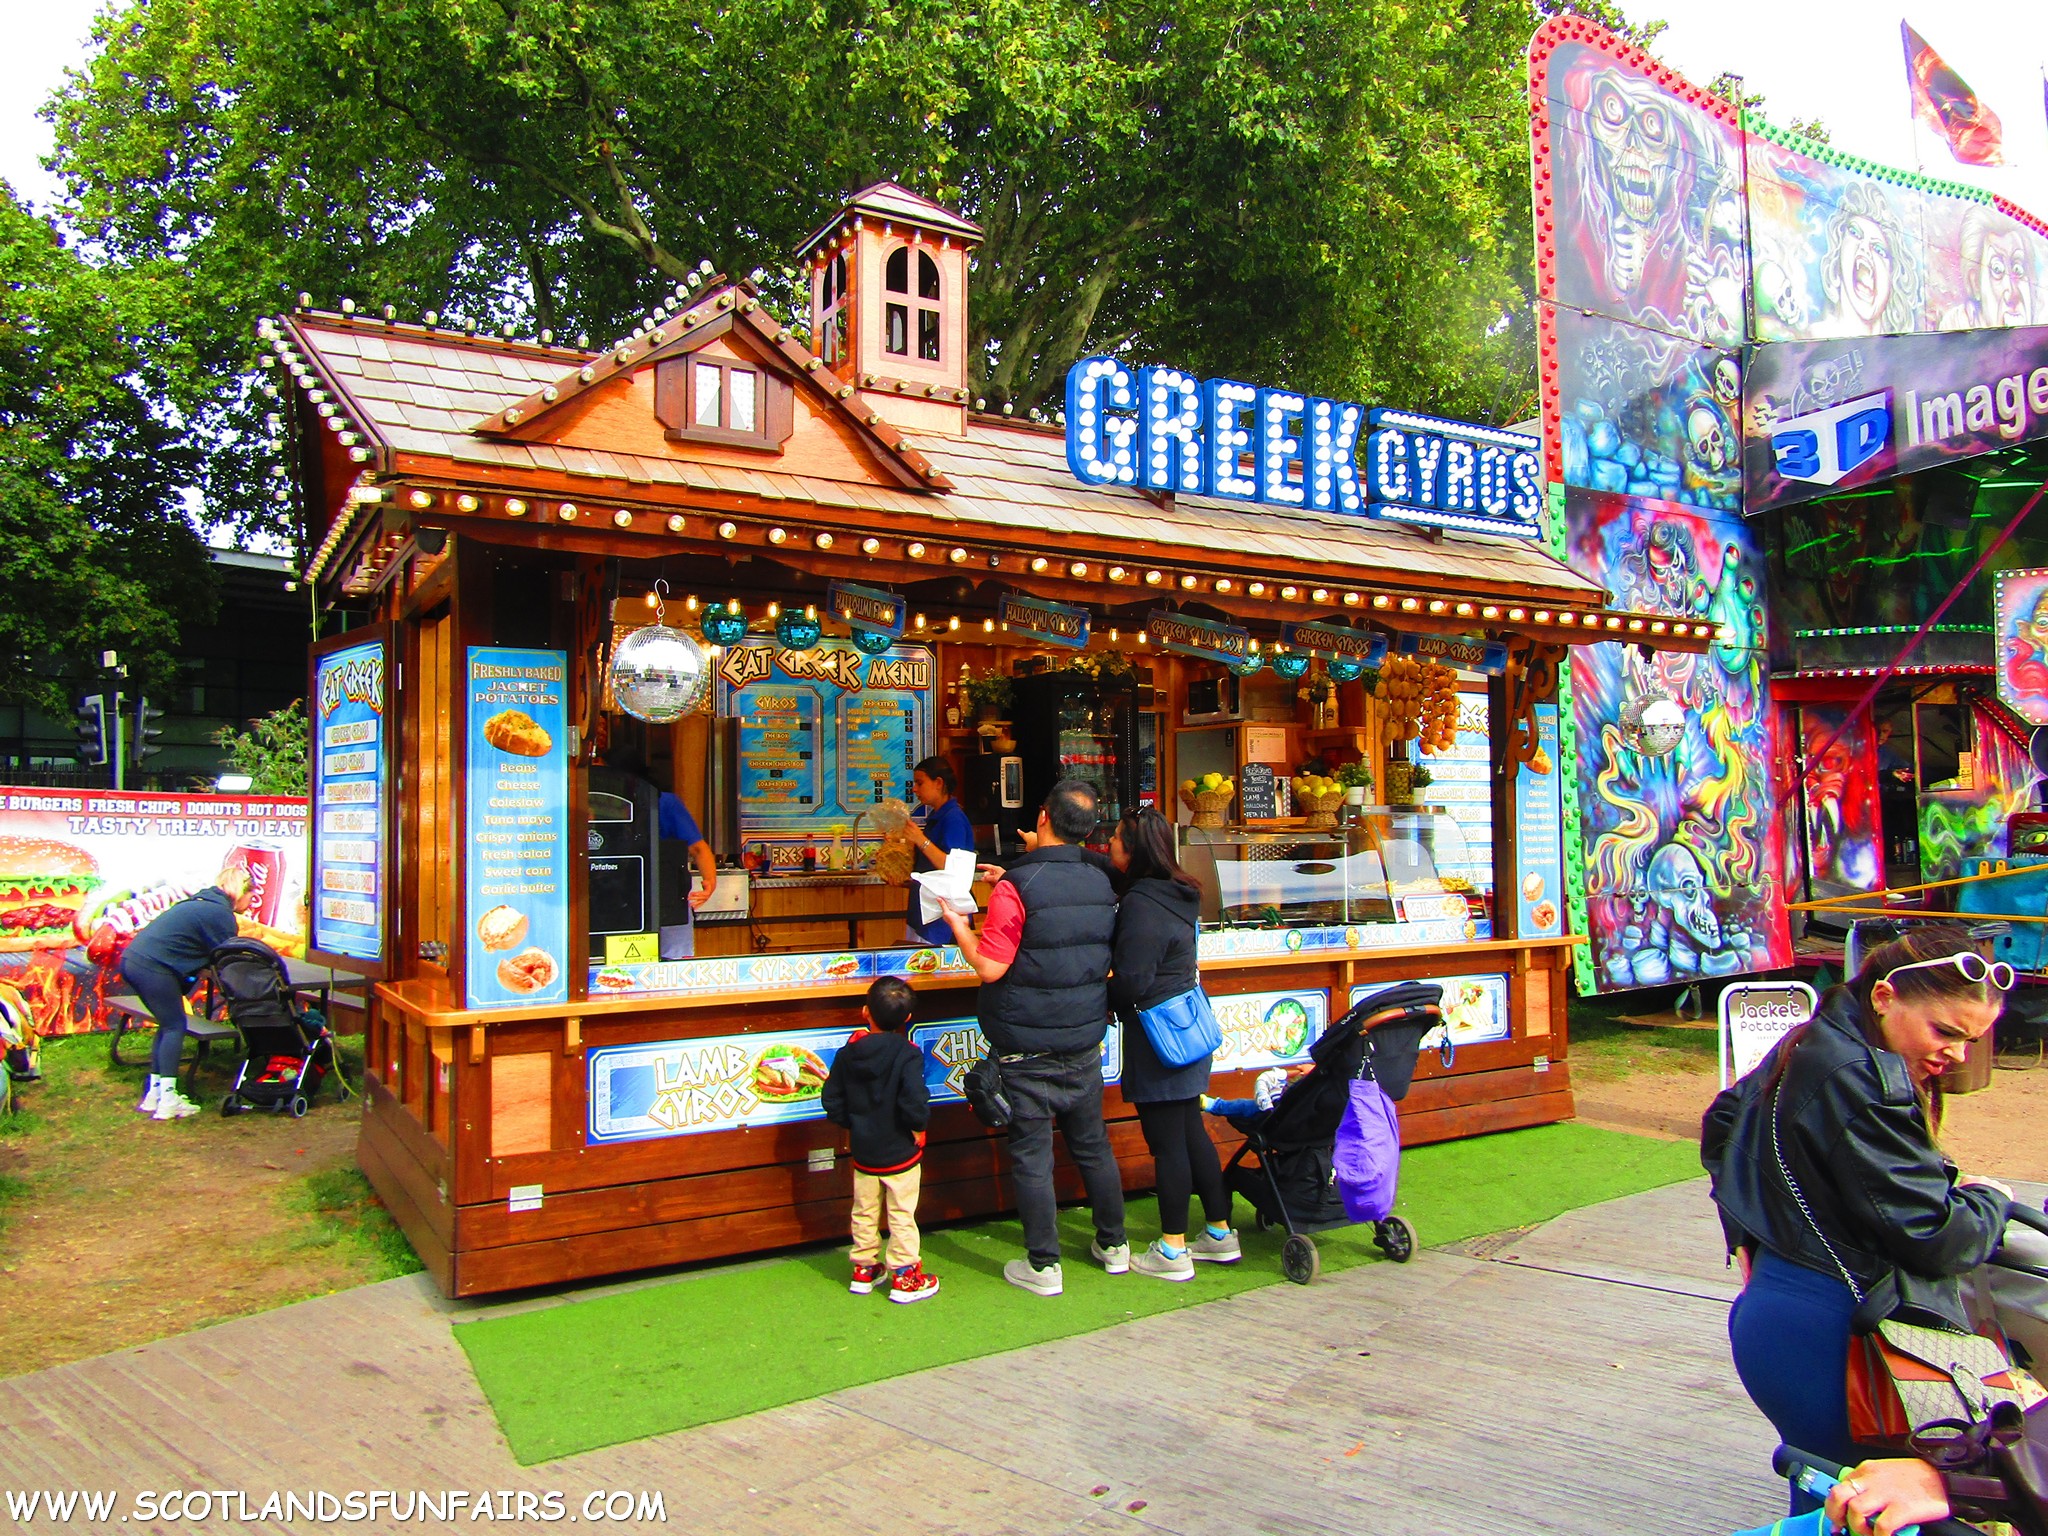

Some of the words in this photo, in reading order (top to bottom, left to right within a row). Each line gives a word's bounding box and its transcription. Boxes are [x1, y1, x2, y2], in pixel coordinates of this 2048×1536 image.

[1066, 355, 1366, 515] GREEK
[1771, 407, 1889, 478] 3D
[1369, 428, 1541, 522] GYROS
[835, 591, 872, 618] HALLOUMI
[1006, 604, 1048, 631] HALLOUMI
[1151, 618, 1187, 640] CHICKEN
[1294, 627, 1333, 650] CHICKEN
[1335, 637, 1370, 656] GYROS
[1417, 638, 1447, 655] LAMB
[1449, 645, 1485, 663] GYROS
[472, 662, 522, 679] FRESHLY
[524, 666, 561, 682] BAKED
[721, 647, 774, 686] EAT
[776, 647, 862, 690] GREEK
[867, 660, 930, 689] MENU
[320, 667, 343, 718] EAT
[343, 658, 384, 714] GREEK
[487, 681, 547, 692] JACKET
[475, 692, 559, 704] POTATOES
[756, 696, 797, 710] GYROS
[500, 763, 537, 773] Beans
[496, 780, 541, 791] Cheese
[9, 796, 82, 812] BURGERS
[88, 798, 137, 814] FRESH
[139, 800, 181, 815] CHIPS
[187, 801, 242, 816] DONUTS
[247, 802, 273, 817] HOT
[275, 803, 308, 817] DOGS
[488, 797, 544, 808] Coleslaw
[68, 816, 151, 835] TASTY
[157, 818, 229, 836] TREAT
[234, 820, 260, 837] TO
[264, 820, 306, 837] EAT
[483, 815, 514, 825] Tuna
[517, 815, 553, 826] mayo
[475, 832, 513, 844] Crispy
[516, 831, 557, 842] onions
[482, 850, 514, 861] Fresh
[517, 848, 551, 859] salad
[772, 847, 804, 863] FRES
[484, 867, 522, 878] Sweet
[525, 866, 551, 876] corn
[590, 863, 618, 871] Potatoes
[480, 883, 518, 895] Garlic
[519, 882, 555, 893] butter
[1405, 901, 1441, 919] CHIPS
[1233, 933, 1282, 952] SALAD
[1361, 926, 1395, 944] SKIN
[1401, 925, 1419, 942] ON
[1425, 921, 1462, 940] FRIES
[637, 961, 739, 989] CHICKEN
[749, 956, 825, 981] GYROS
[1740, 1001, 1800, 1018] Jacket
[932, 1029, 992, 1066] CHIC
[1239, 1022, 1281, 1056] BOX
[654, 1045, 749, 1094] LAMB
[648, 1076, 761, 1130] GYROS
